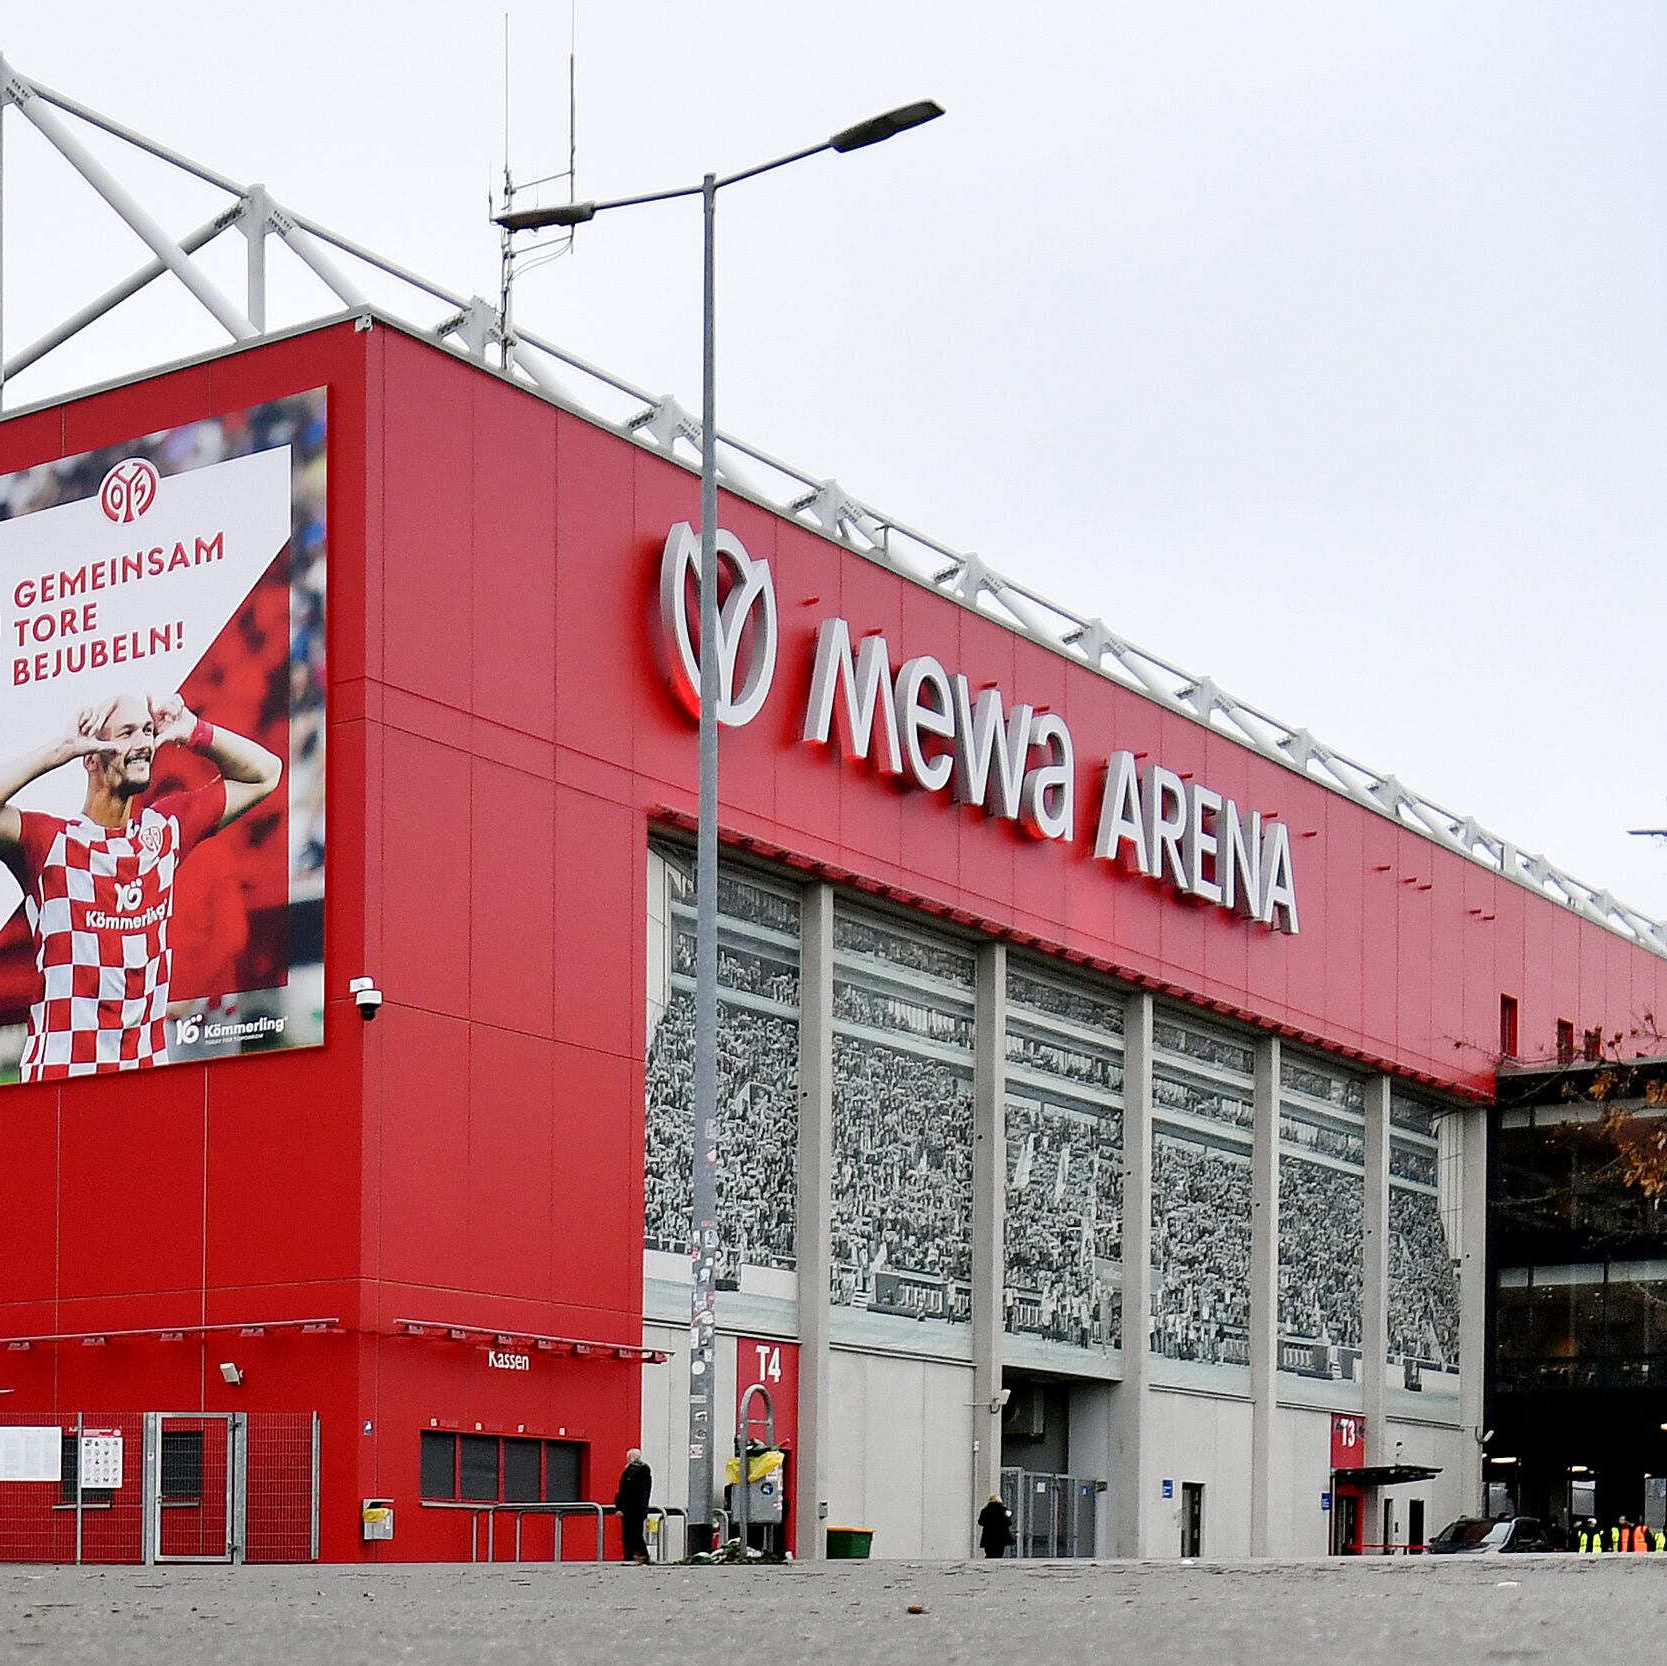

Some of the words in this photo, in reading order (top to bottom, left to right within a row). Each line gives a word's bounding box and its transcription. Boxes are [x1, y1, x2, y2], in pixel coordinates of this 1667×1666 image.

[13, 531, 226, 610] GEMEINSAM
[14, 602, 98, 648] TORE
[12, 621, 185, 687] BEJUBELN!
[1093, 750, 1299, 935] ARENA
[204, 1016, 285, 1038] Kömmerling
[488, 1350, 530, 1371] Kassen
[755, 1345, 782, 1383] T4
[1340, 1418, 1356, 1448] T3
